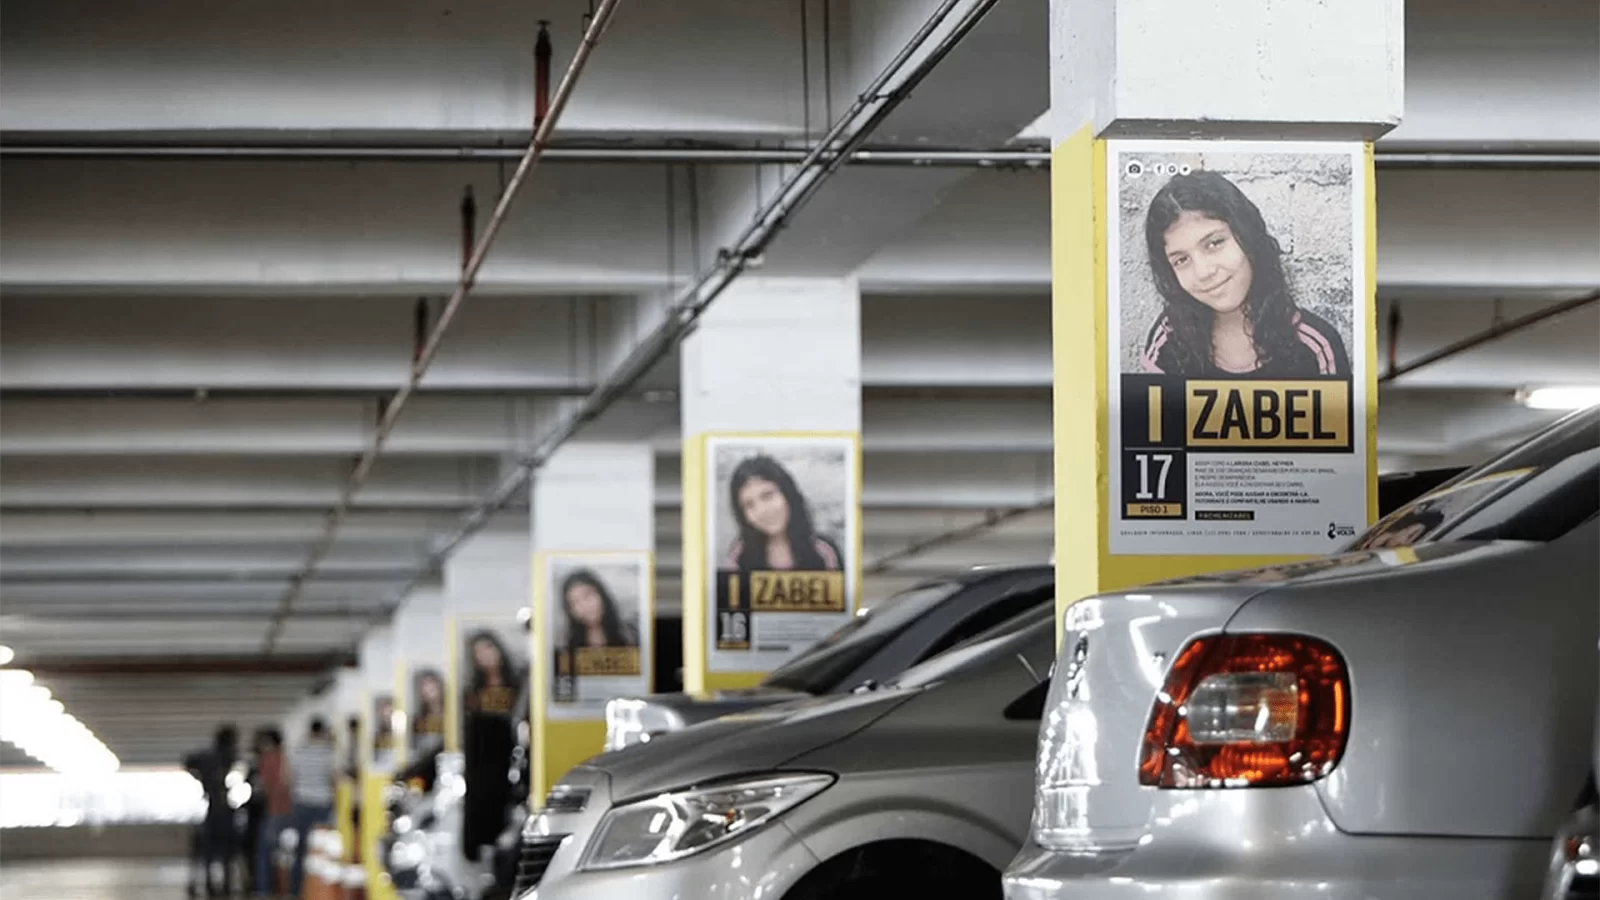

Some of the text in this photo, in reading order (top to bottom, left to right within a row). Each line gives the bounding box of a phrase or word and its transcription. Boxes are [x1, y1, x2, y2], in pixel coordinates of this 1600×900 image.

[1148, 385, 1337, 443] I ZABEL
[1135, 454, 1173, 499] 17
[1162, 504, 1168, 513] 1
[756, 576, 838, 606] ZABEL
